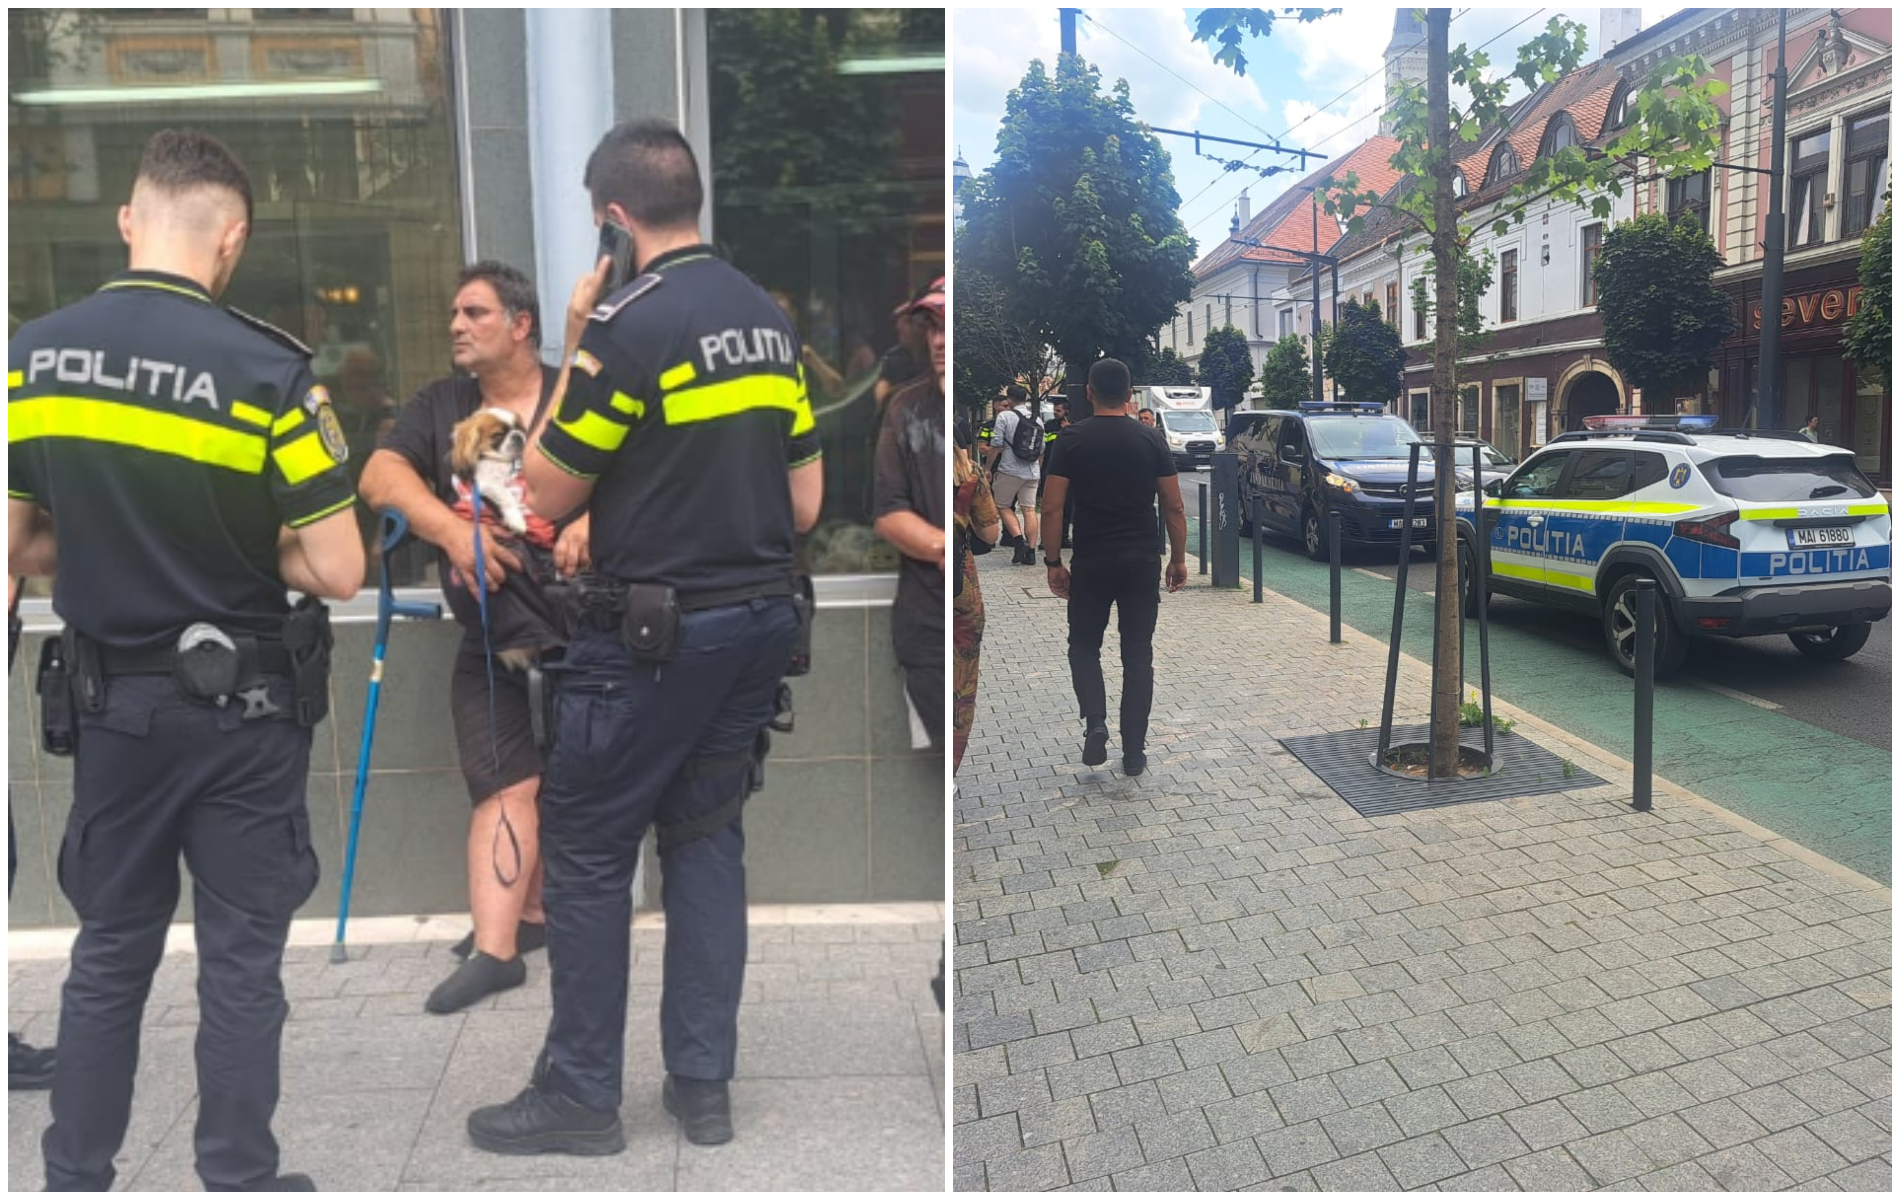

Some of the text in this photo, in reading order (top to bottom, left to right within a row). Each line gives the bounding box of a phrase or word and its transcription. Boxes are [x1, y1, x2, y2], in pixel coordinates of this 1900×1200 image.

[699, 326, 792, 372] POLITIA
[28, 348, 220, 411] POLITIA
[1798, 506, 1850, 517] DACIA
[1507, 525, 1586, 558] POLITIA
[1797, 527, 1850, 543] MAI 61880
[1769, 547, 1870, 576] POLITIA
